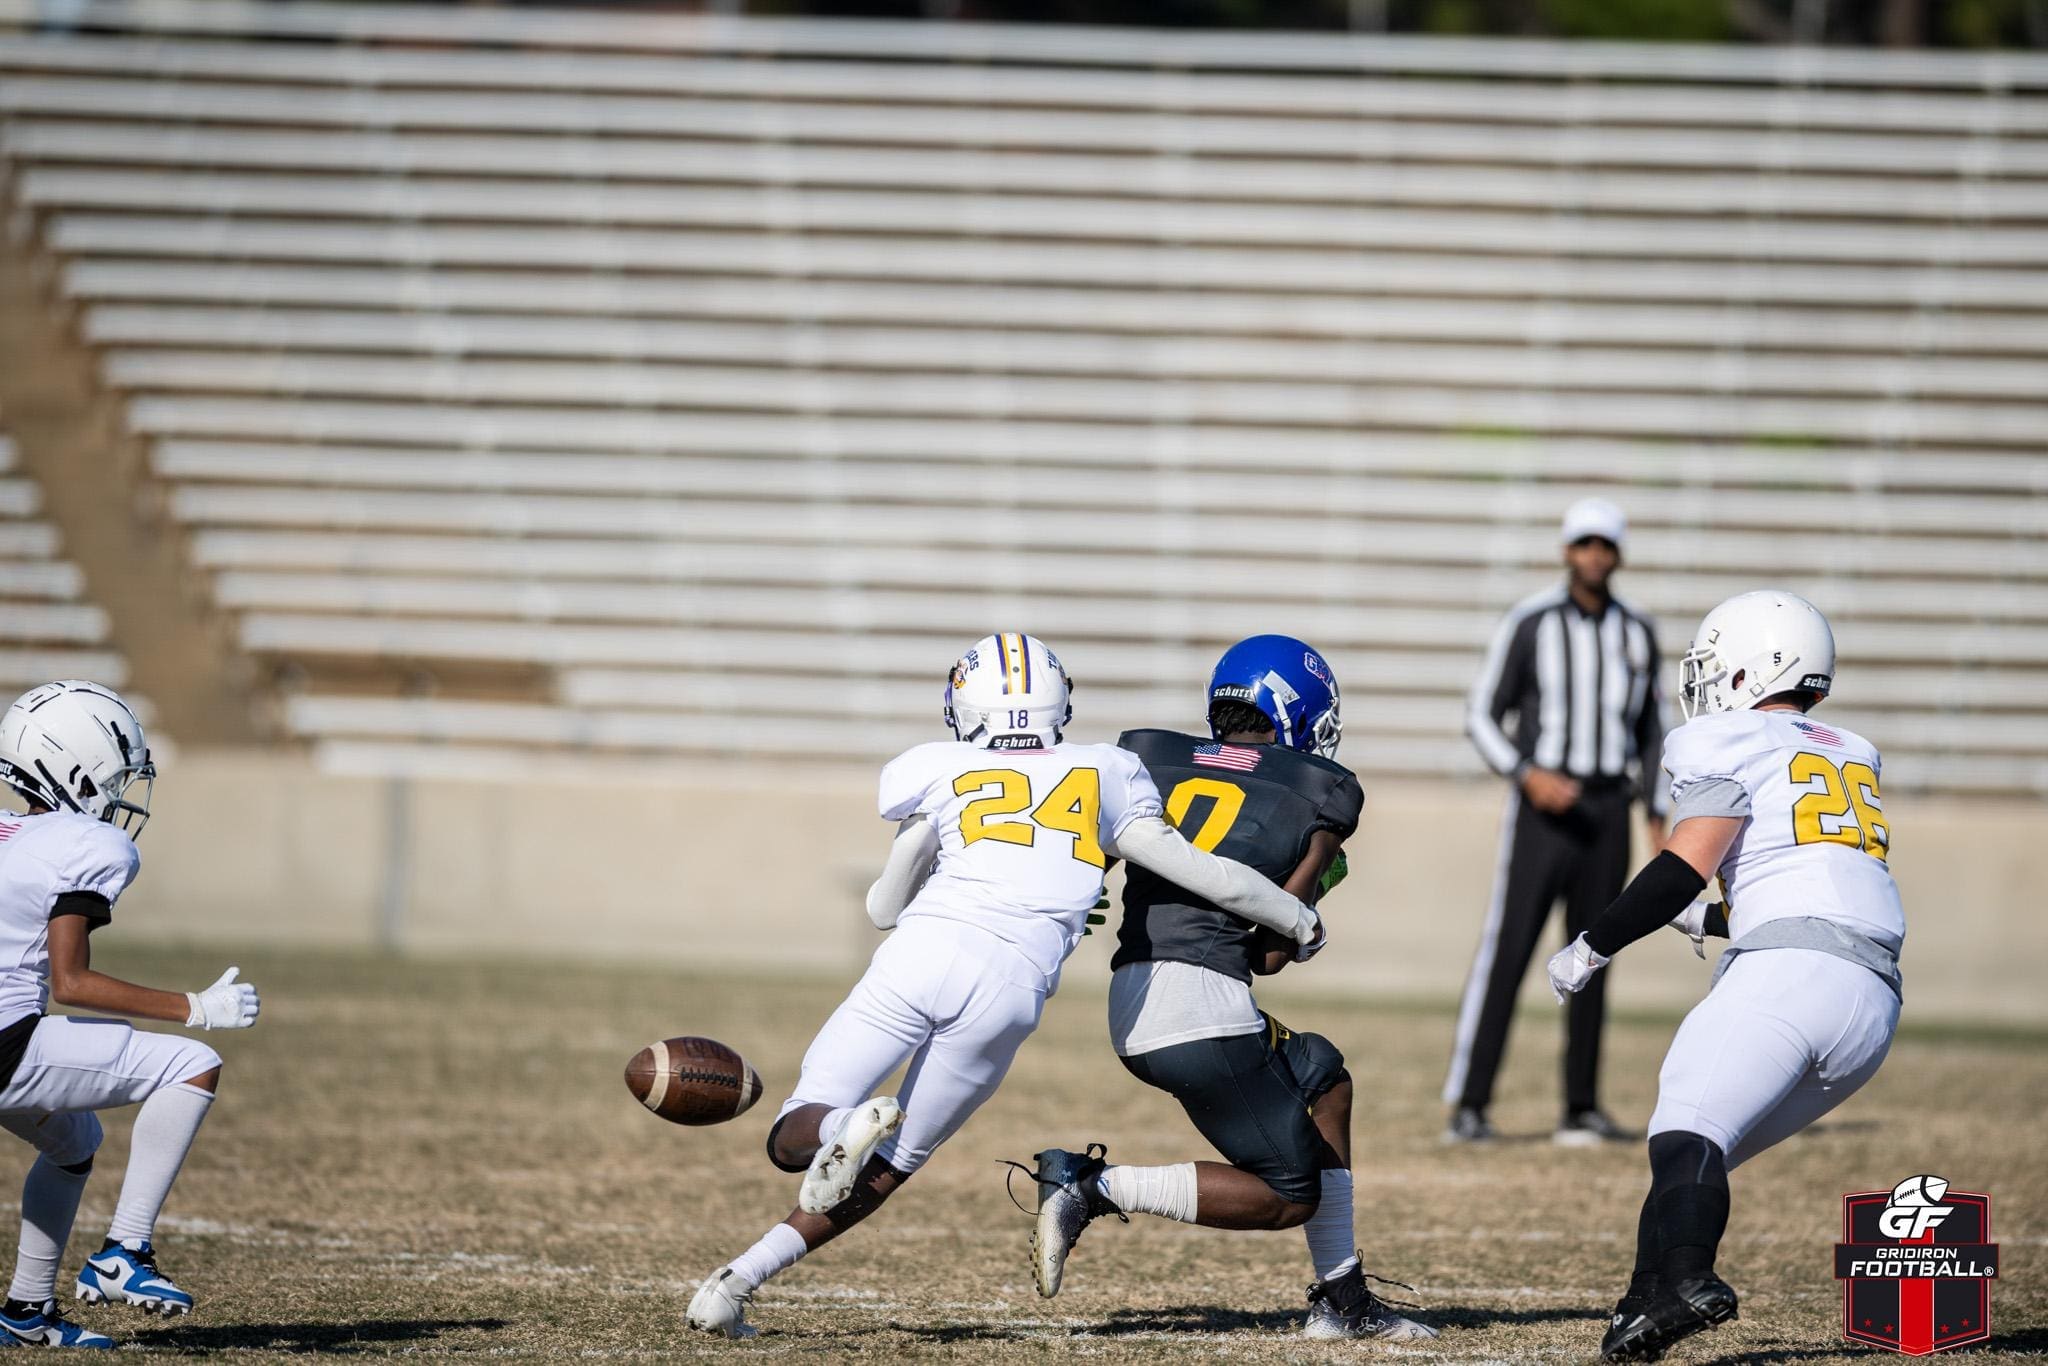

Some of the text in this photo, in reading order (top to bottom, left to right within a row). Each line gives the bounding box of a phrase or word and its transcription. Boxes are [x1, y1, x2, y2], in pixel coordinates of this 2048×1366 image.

[993, 736, 1038, 748] schutt
[1008, 709, 1029, 729] 18
[952, 767, 1106, 869] 24
[1788, 751, 1890, 863] 26
